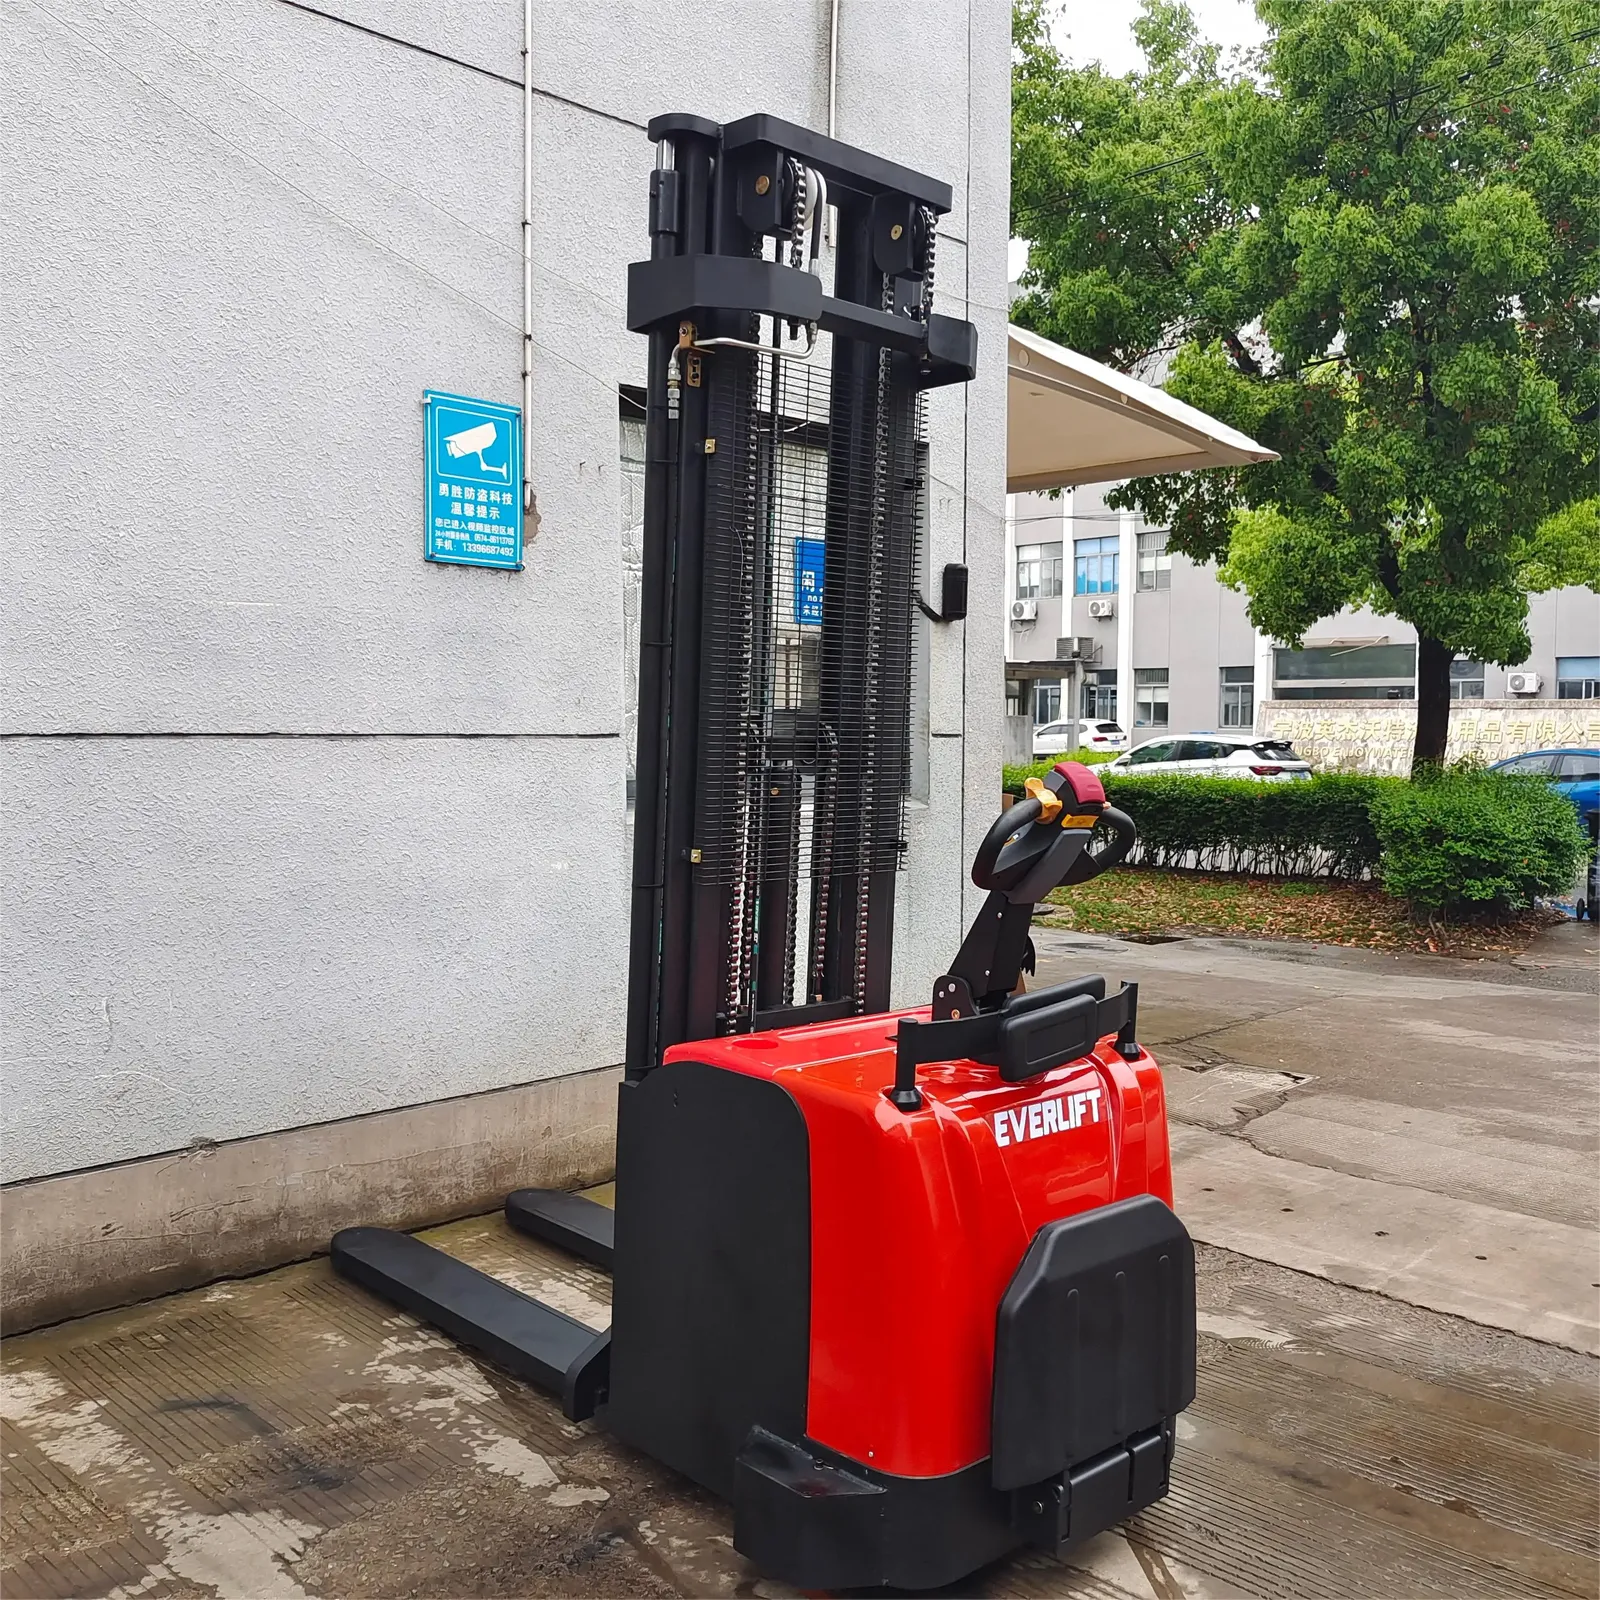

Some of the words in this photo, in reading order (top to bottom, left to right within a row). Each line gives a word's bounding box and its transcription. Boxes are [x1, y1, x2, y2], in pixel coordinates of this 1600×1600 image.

[439, 482, 513, 506] 勇胜防盗科技
[451, 501, 501, 520] 温馨提示
[435, 517, 515, 536] 您已进入视频监控区域
[462, 542, 514, 557] 13396687492
[993, 1088, 1102, 1148] EVERLIFT
